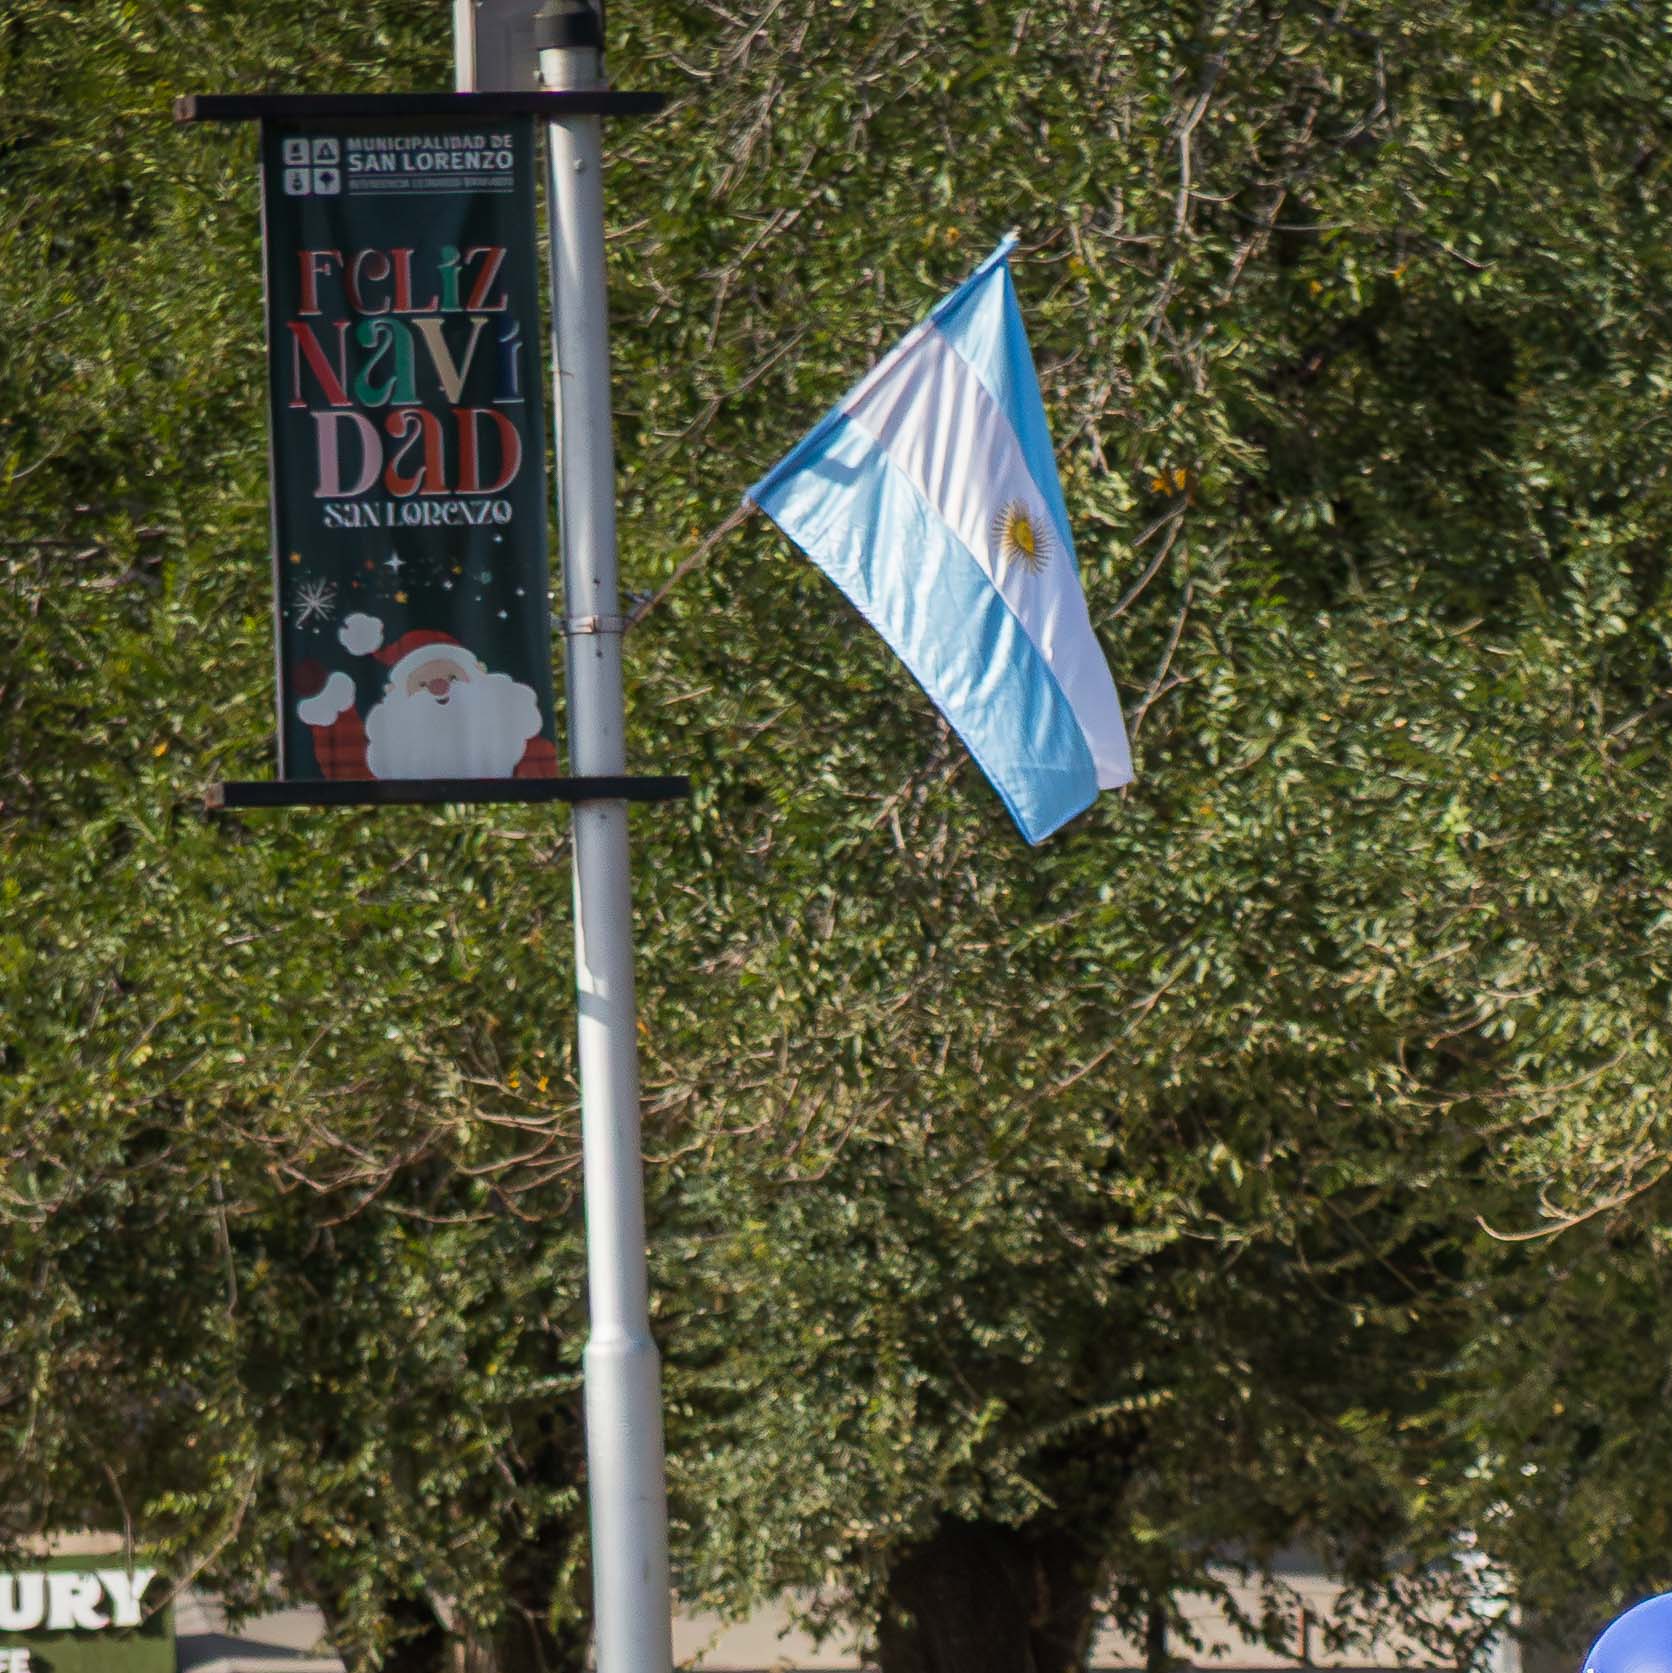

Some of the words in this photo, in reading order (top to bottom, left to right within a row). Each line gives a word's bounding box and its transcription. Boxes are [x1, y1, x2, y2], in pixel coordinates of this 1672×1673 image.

[348, 136, 485, 150] MUNICIPALIDAD
[490, 135, 513, 148] DE
[348, 153, 396, 172] SAN
[402, 151, 514, 170] LORENZO
